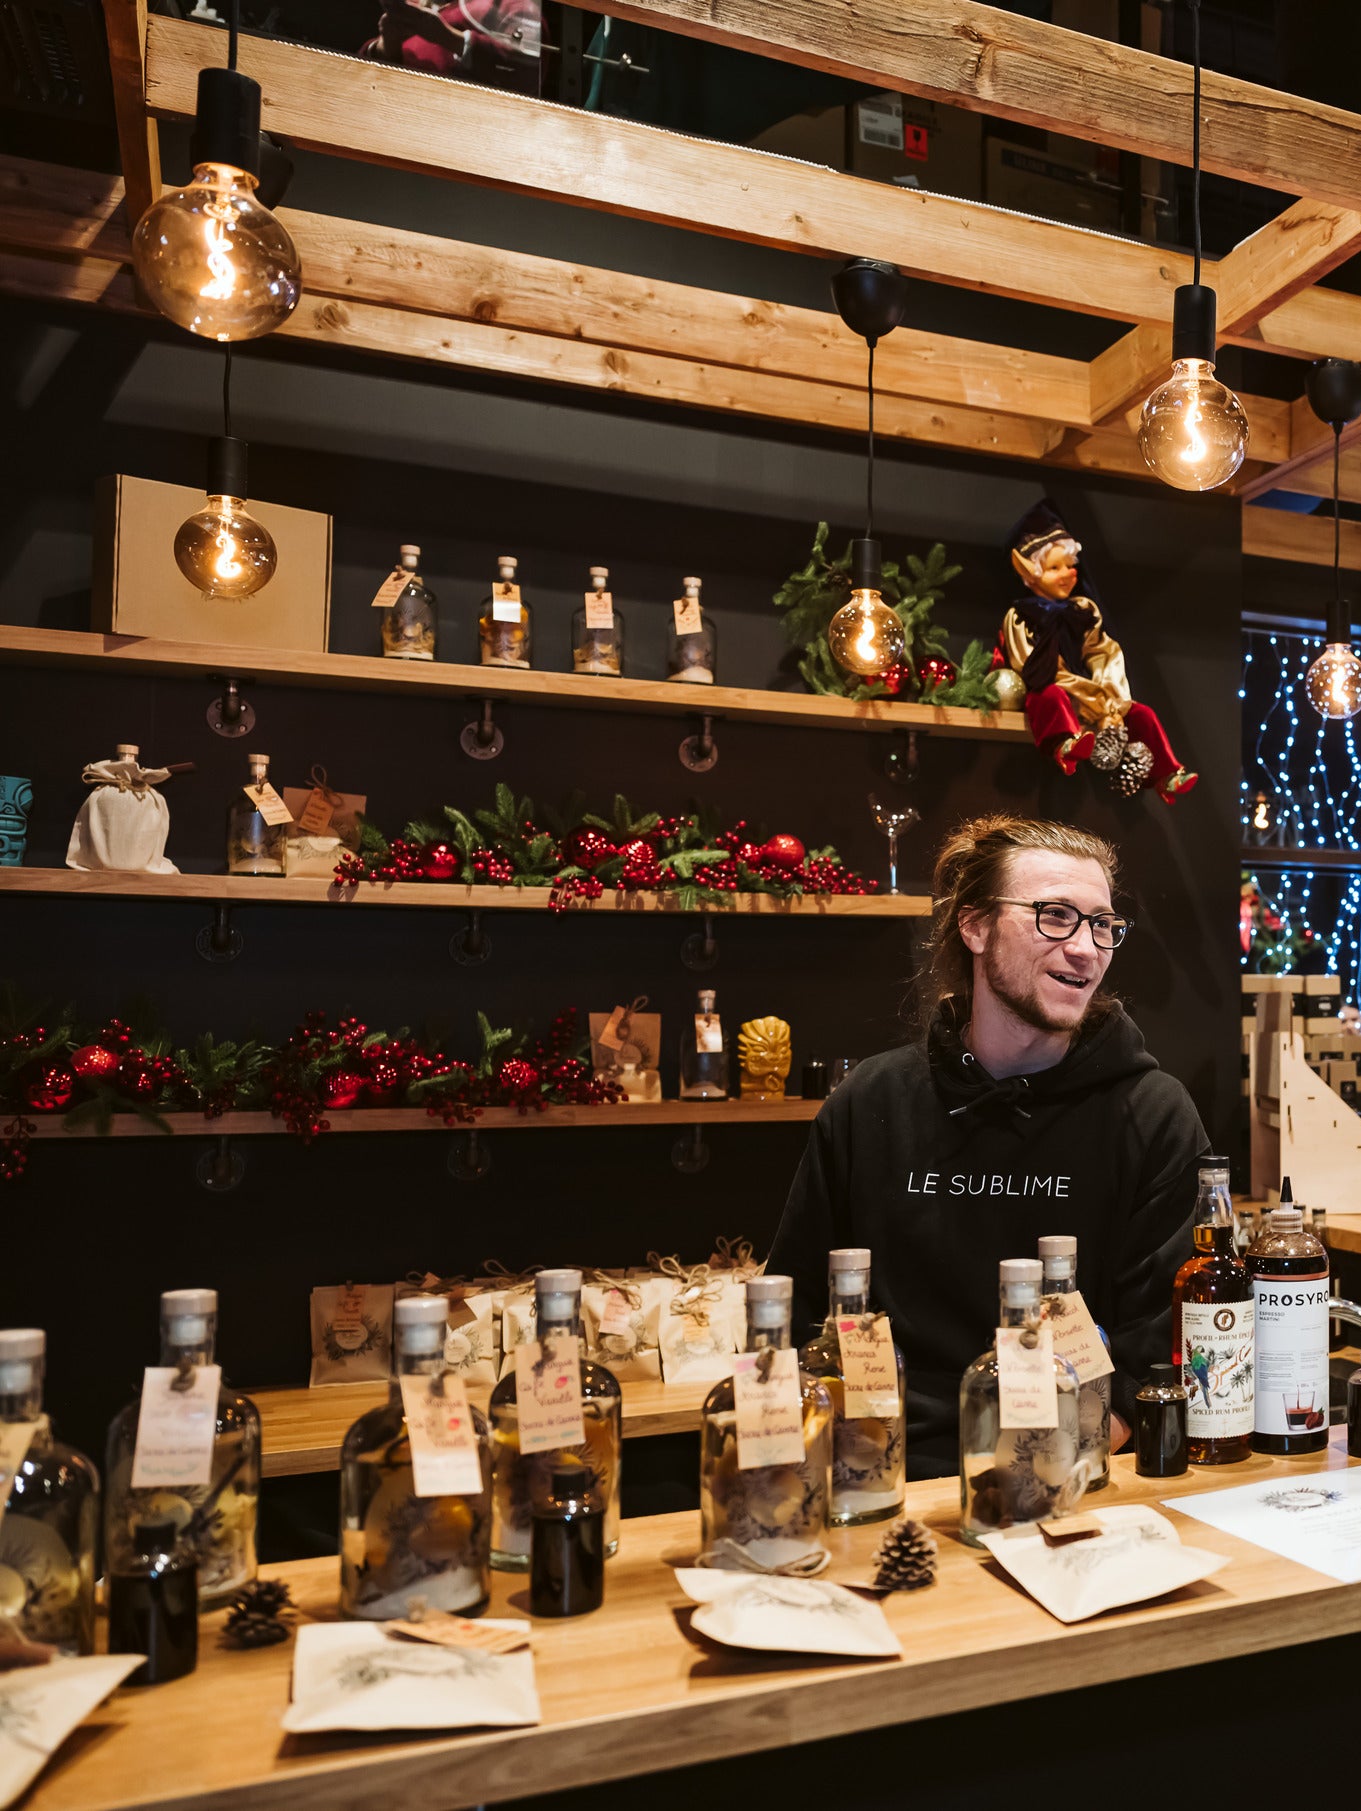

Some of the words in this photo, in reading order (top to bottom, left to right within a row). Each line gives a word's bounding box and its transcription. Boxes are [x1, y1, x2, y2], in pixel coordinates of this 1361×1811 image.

[907, 1171, 940, 1194] LE
[948, 1174, 1071, 1198] SUBLIME
[1259, 1290, 1329, 1307] PROSYRO
[1232, 1405, 1250, 1414] PROFIL
